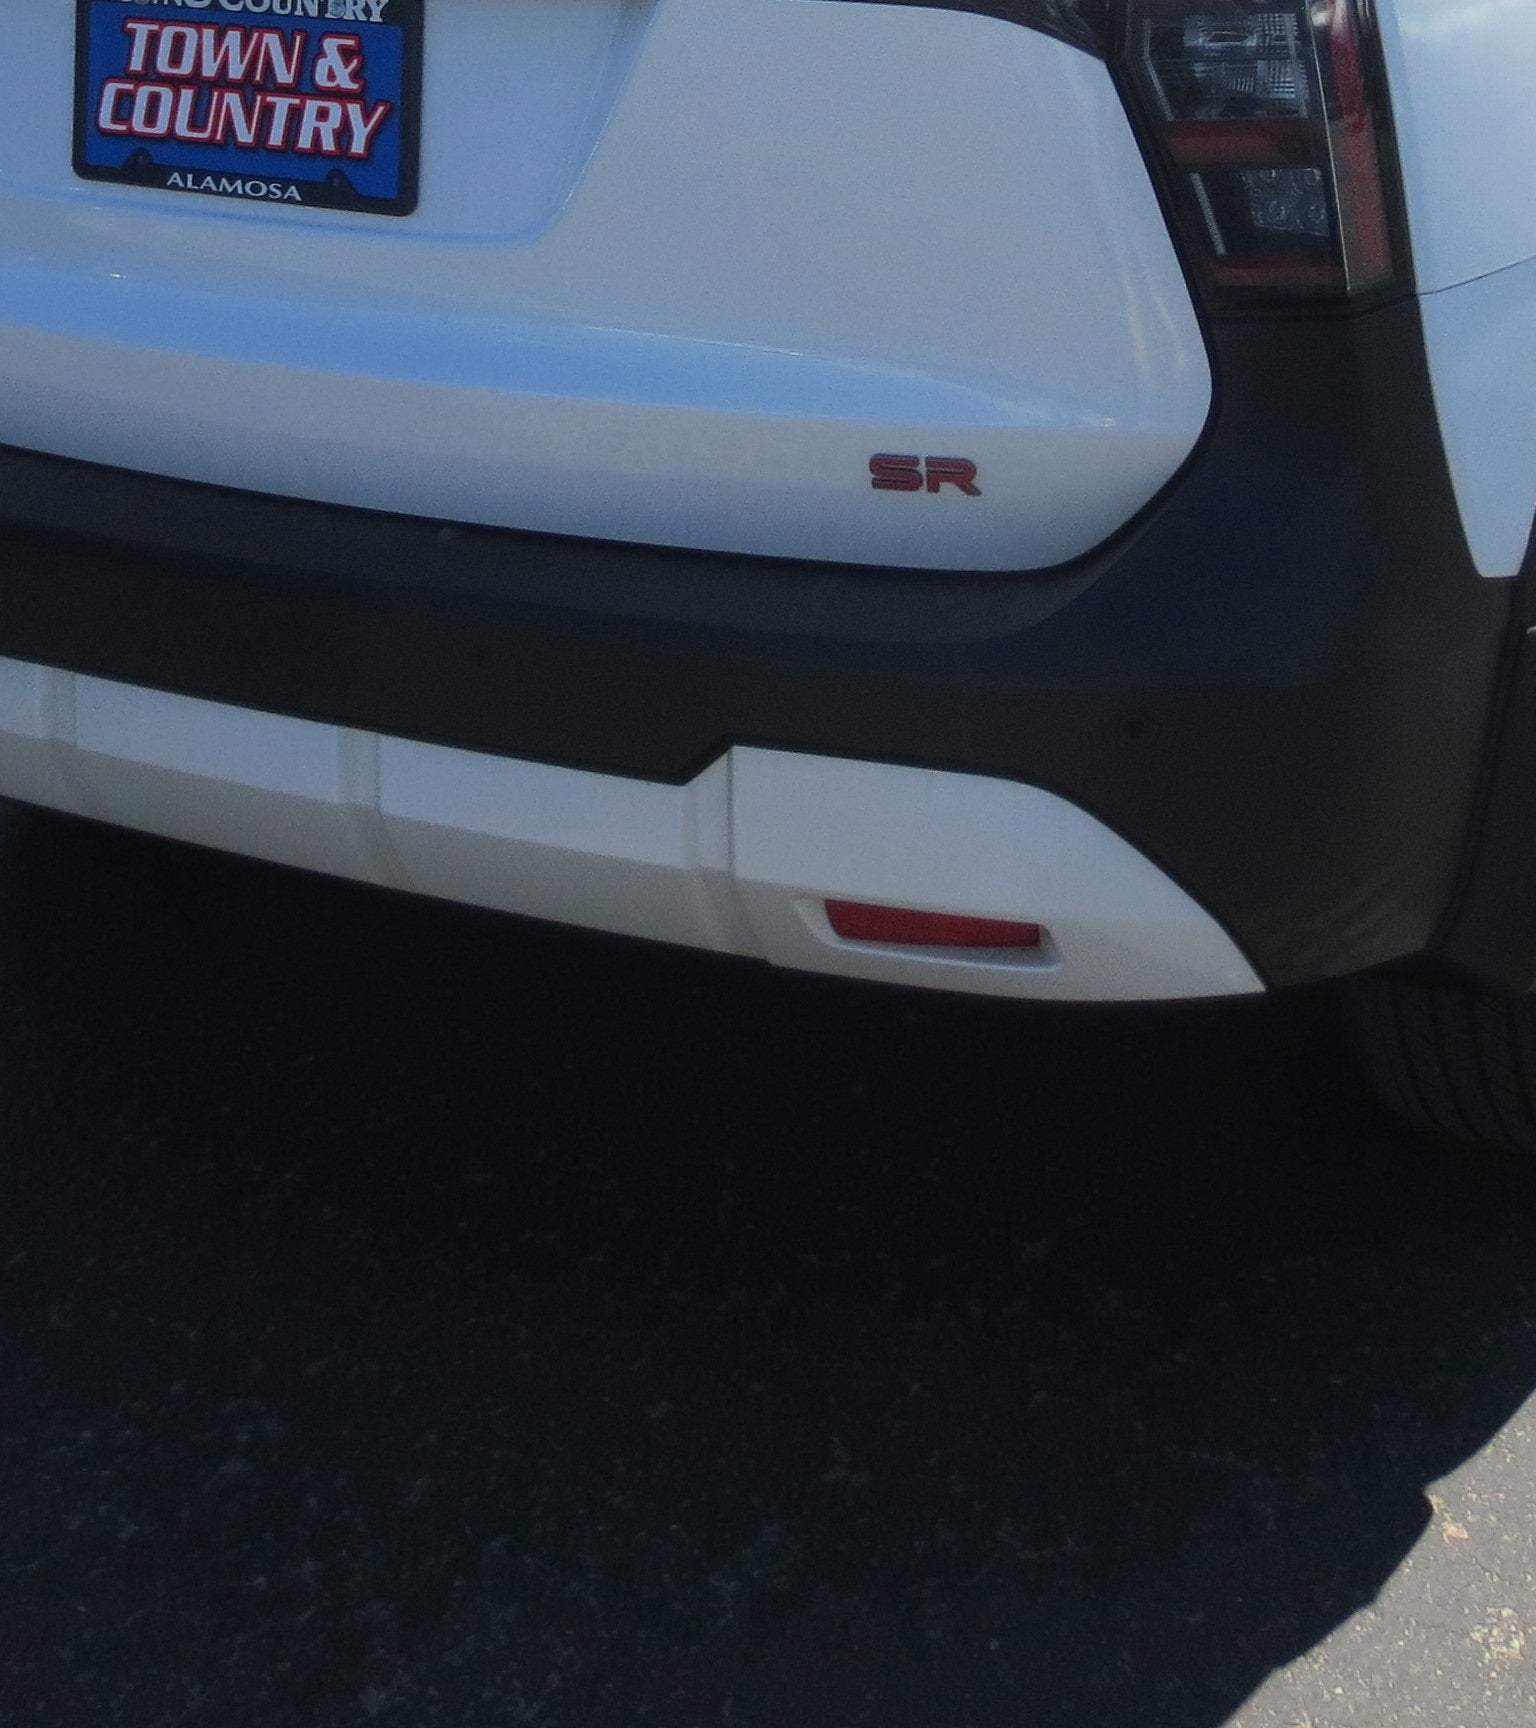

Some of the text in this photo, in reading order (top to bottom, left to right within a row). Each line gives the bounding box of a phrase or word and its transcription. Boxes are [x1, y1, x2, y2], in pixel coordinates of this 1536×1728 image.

[124, 18, 363, 92] TOWN &
[97, 78, 392, 159] COUNTRY
[166, 170, 303, 203] ALAMOSA
[869, 453, 982, 496] SR
